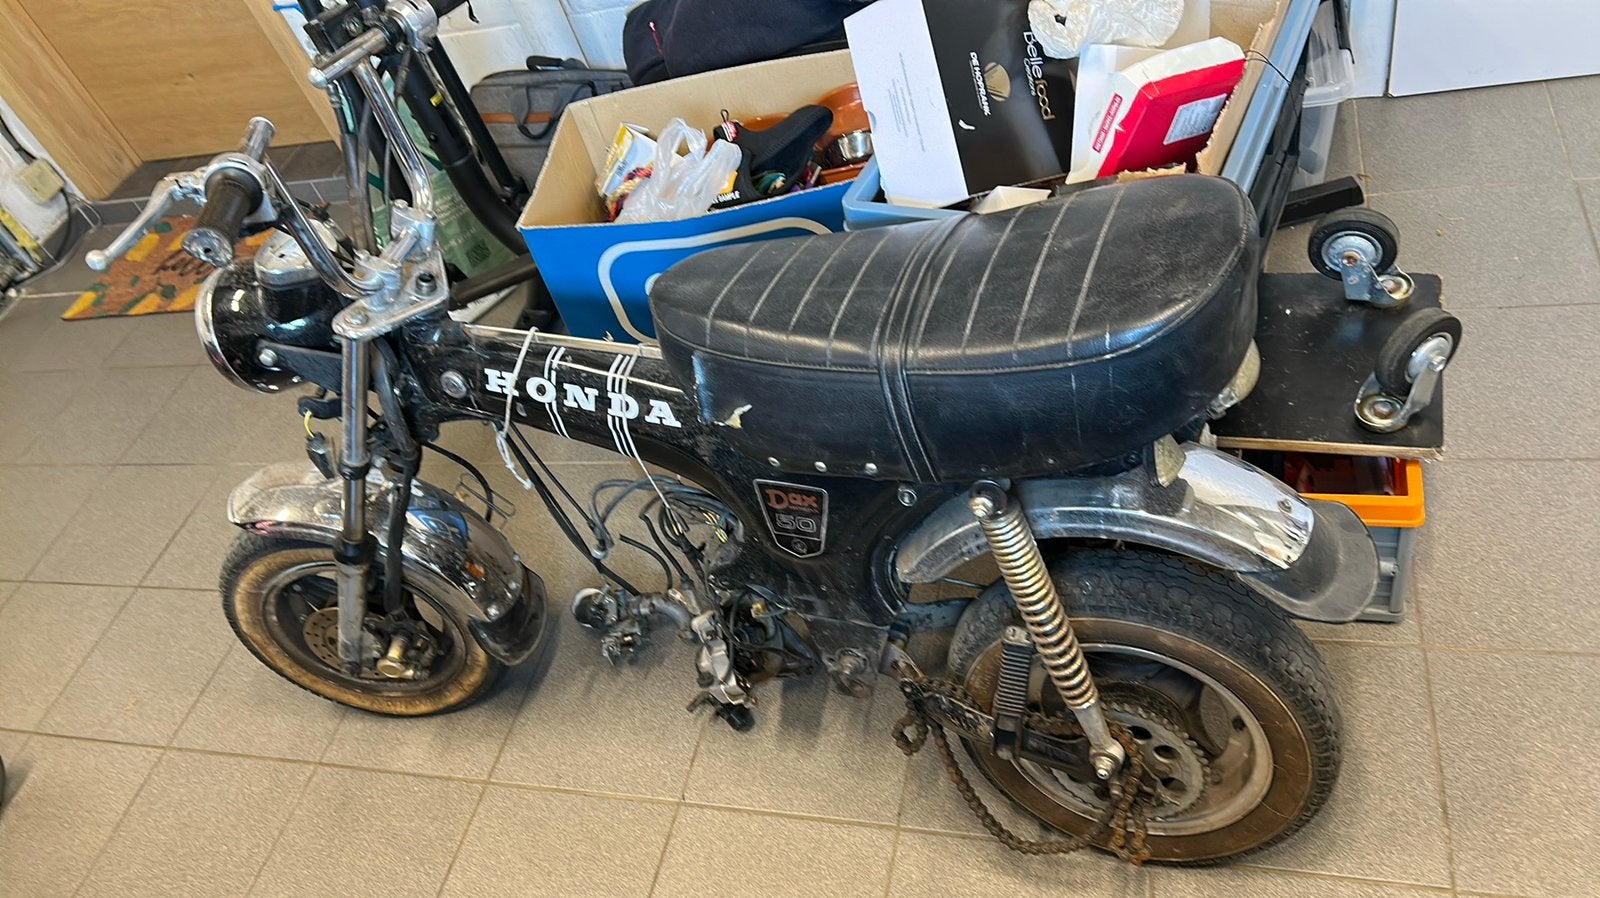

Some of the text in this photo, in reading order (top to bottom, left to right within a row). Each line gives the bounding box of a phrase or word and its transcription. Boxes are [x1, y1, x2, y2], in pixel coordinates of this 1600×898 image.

[969, 51, 980, 67] DE
[484, 368, 682, 428] HONDA
[765, 489, 818, 510] Dax
[775, 513, 816, 533] 50
